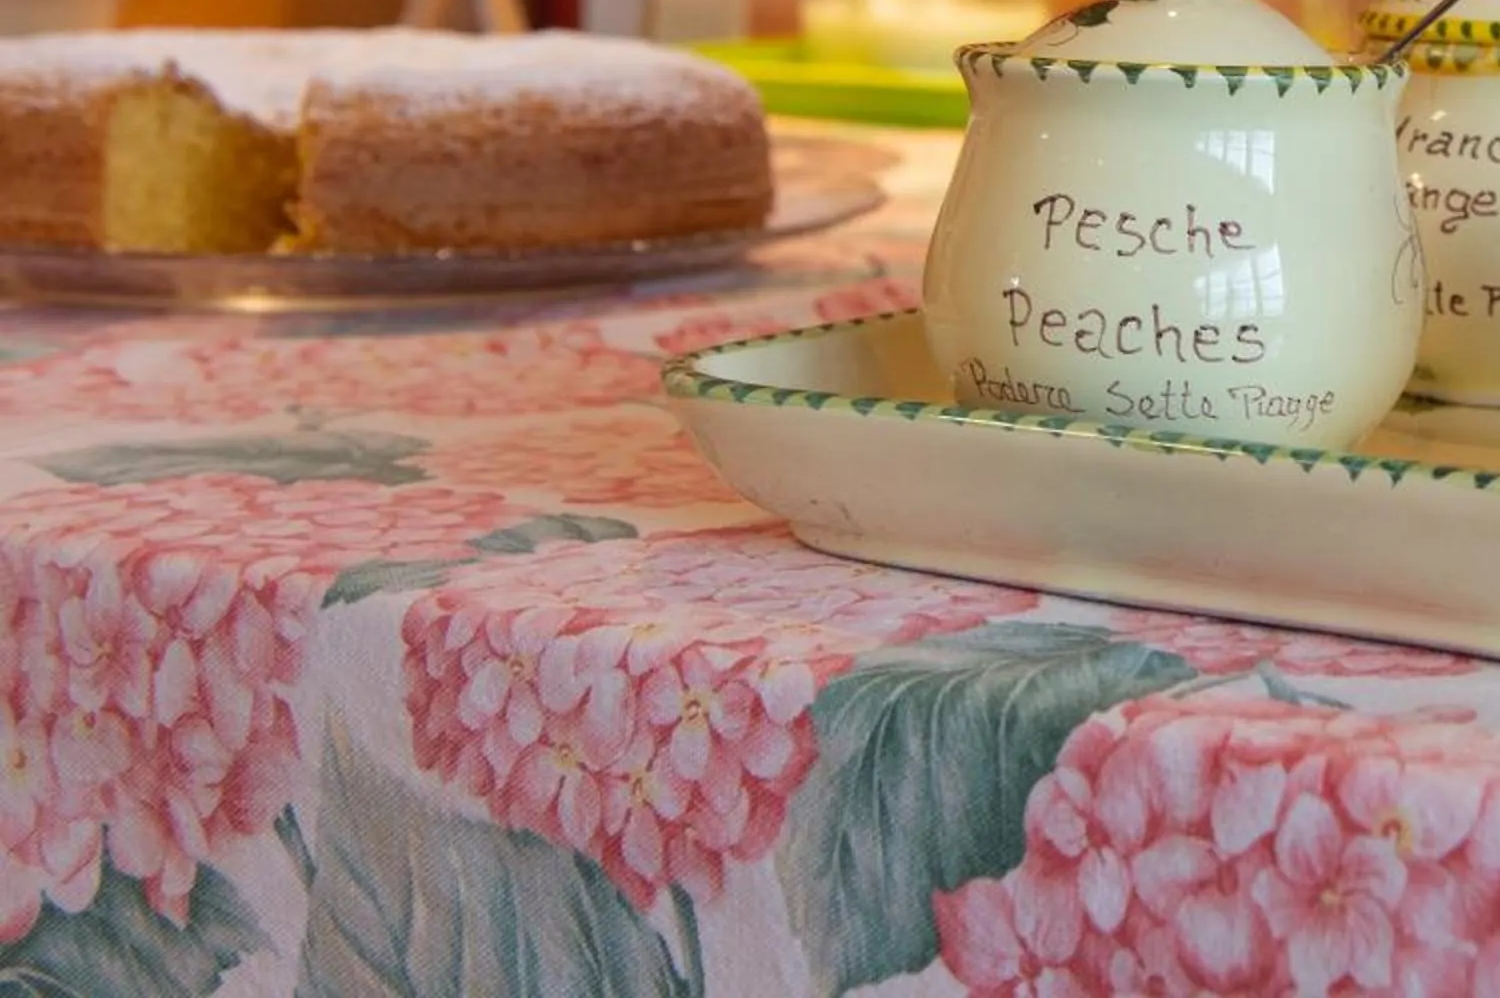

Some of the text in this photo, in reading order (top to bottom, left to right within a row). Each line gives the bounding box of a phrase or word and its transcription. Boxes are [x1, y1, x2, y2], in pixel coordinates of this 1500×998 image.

[1034, 193, 1255, 258] Pesche
[1426, 281, 1470, 316] te
[1003, 288, 1266, 363] Peaches
[1105, 380, 1217, 421] Sette
